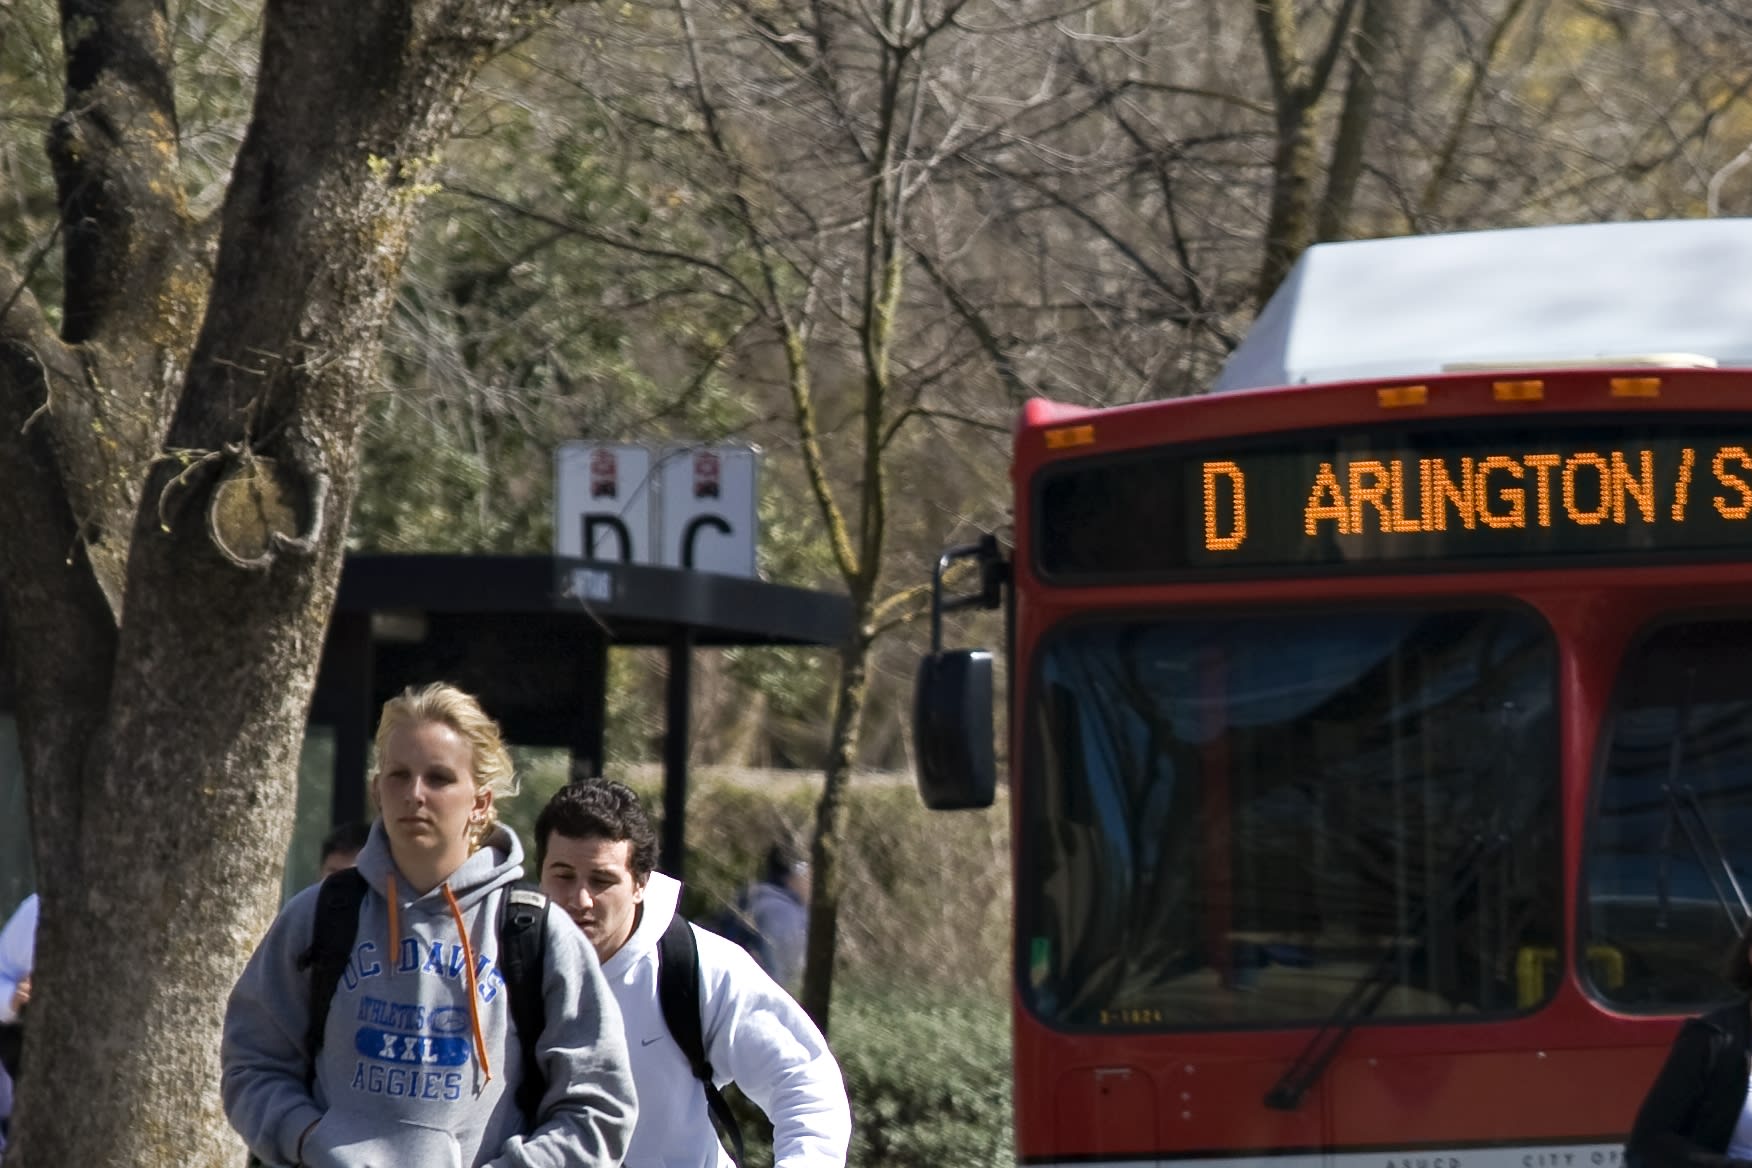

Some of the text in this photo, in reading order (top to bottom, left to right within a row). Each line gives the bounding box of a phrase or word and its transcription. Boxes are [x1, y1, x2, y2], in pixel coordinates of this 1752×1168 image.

[1203, 461, 1246, 550] D
[1304, 449, 1655, 536] ARLINGTON
[1671, 448, 1695, 522] /
[342, 938, 505, 1004] UC DAVIS
[378, 1033, 437, 1063] XXL
[352, 1062, 462, 1100] AGGIES
[1522, 1153, 1575, 1168] CITY
